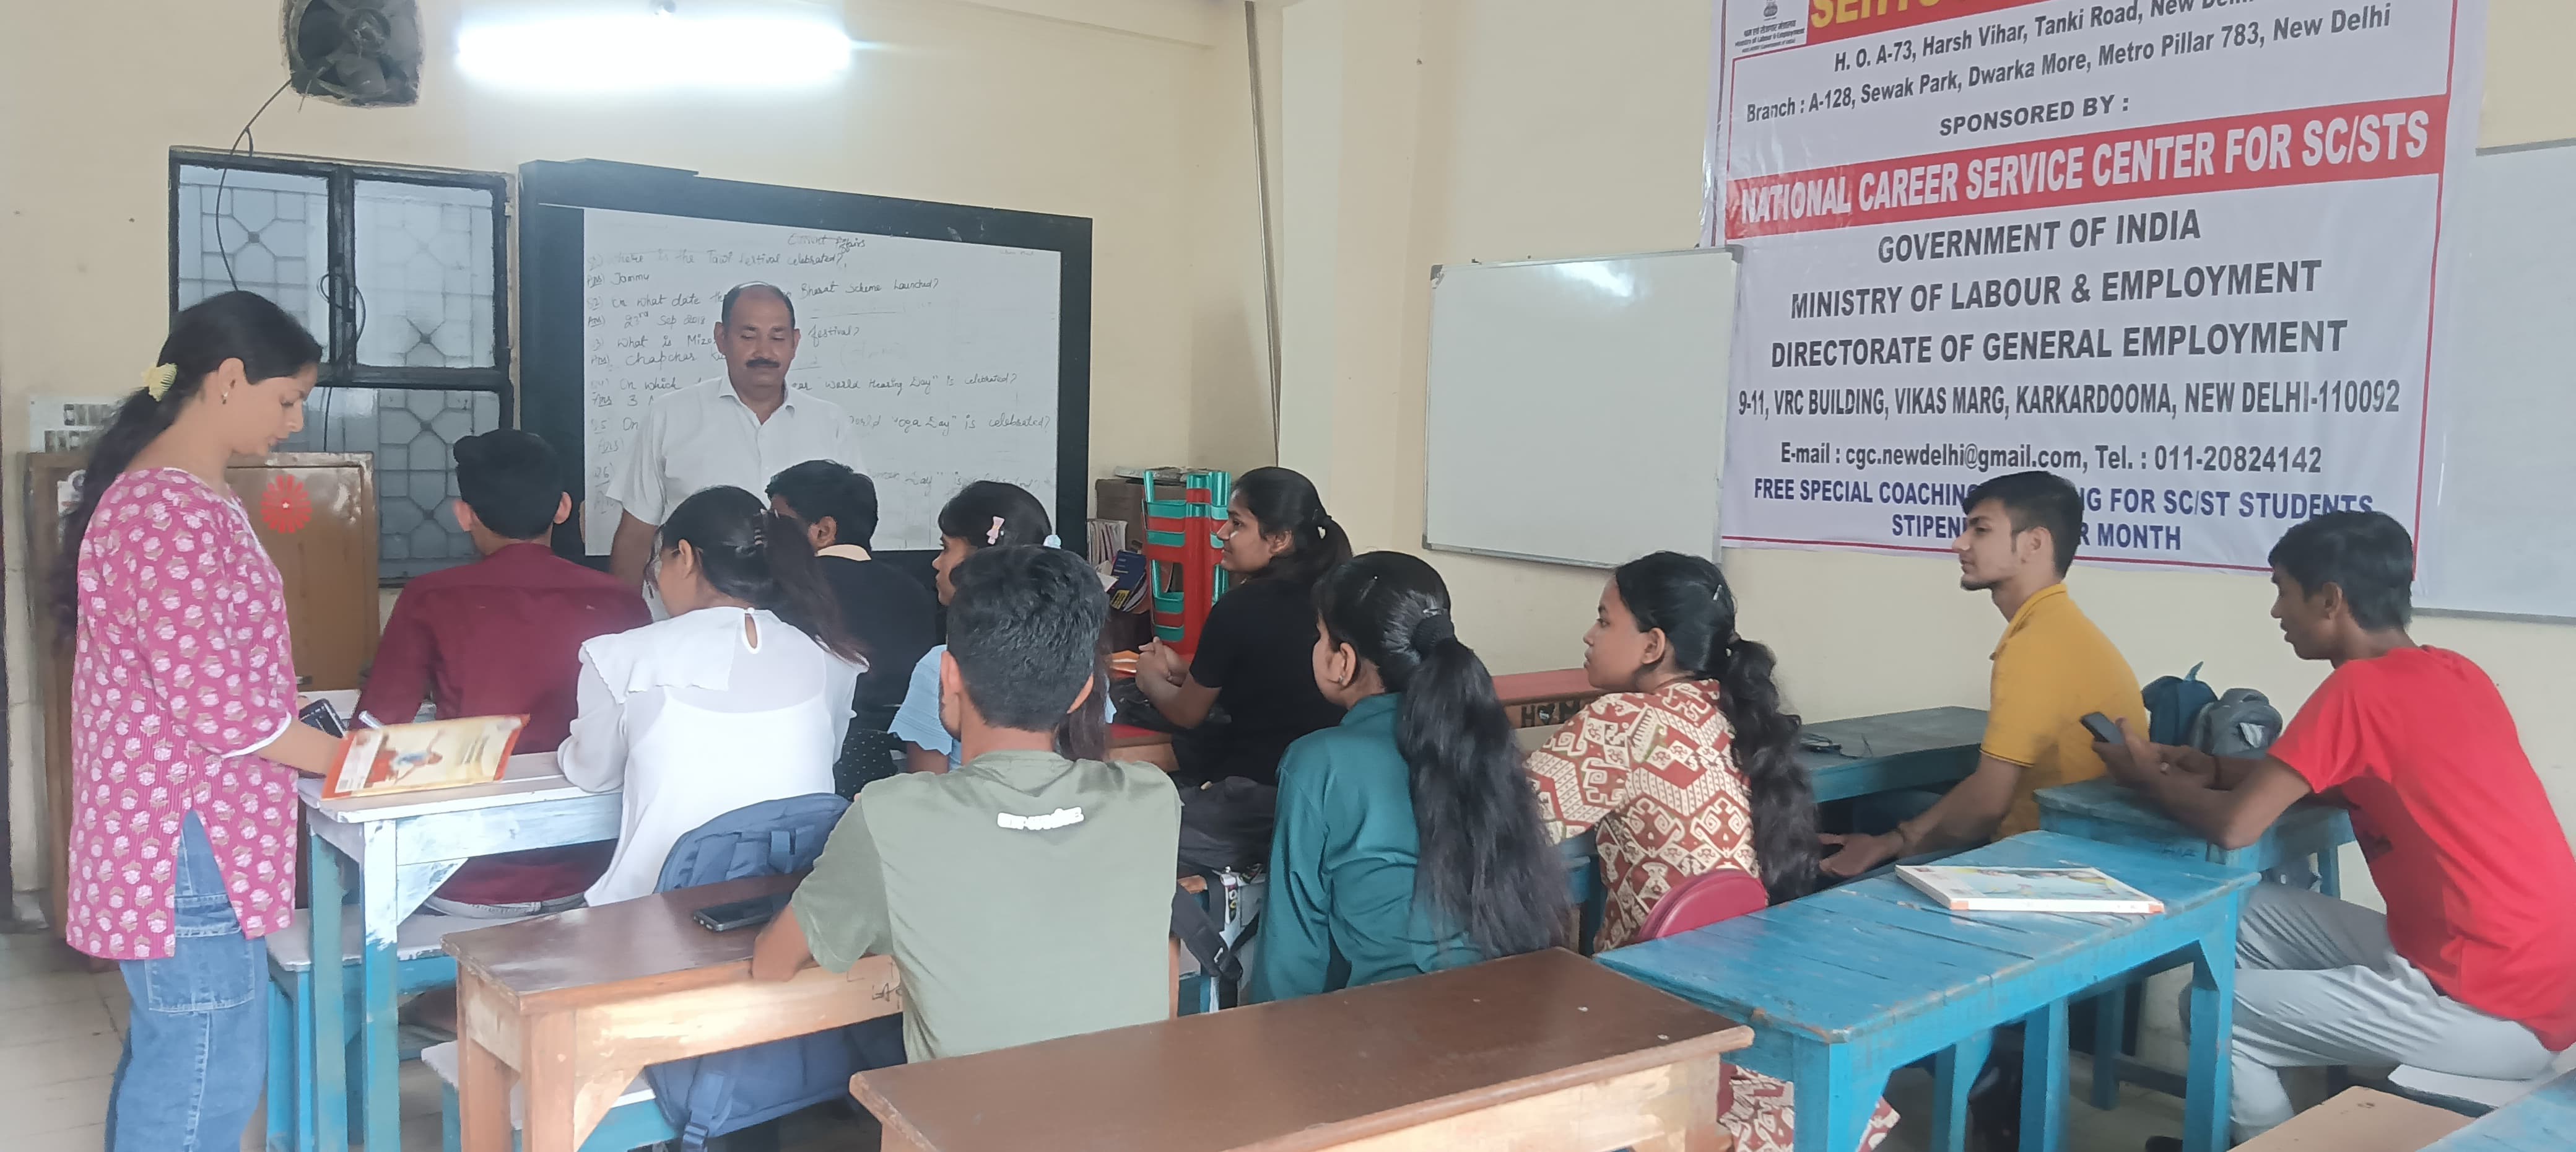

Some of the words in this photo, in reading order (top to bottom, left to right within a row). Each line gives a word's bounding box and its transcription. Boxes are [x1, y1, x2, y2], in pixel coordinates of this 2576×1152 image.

[1835, 52, 1850, 72] H.
[1856, 49, 1870, 68] O.
[1876, 40, 1916, 64] A-73,
[1923, 30, 1972, 56] Harsh
[1979, 24, 2027, 46] Vihar,
[2035, 9, 2084, 37] Tanki
[2091, 0, 2143, 27] Road,
[2151, 0, 2194, 17] New
[1747, 97, 1795, 122] Branch
[1801, 100, 1804, 113] :
[1809, 87, 1855, 111] A-128,
[1861, 77, 1913, 103] Sewak
[1920, 71, 1962, 94] Park,
[1969, 59, 2034, 86] Dwarka
[2042, 53, 2091, 75] More,
[2099, 41, 2154, 66] Metro
[2162, 32, 2214, 56] Pillar
[2222, 22, 2264, 48] 783,
[2274, 17, 2323, 40] New
[2331, 3, 2390, 33] Delhi
[1940, 101, 2074, 136] SPONSORED
[2083, 95, 2115, 116] BY
[2123, 98, 2128, 111] :
[1741, 177, 1852, 224] NATIONAL
[1859, 163, 1958, 211] CAREER
[1966, 147, 2084, 199] SERVICE
[2093, 133, 2214, 186] CENTER
[2226, 124, 2291, 173] FOR
[2302, 110, 2429, 166] SC/STS
[1879, 221, 2060, 263] GOVERNMENT
[2070, 217, 2106, 248] OF
[2117, 209, 2200, 244] INDIA
[1791, 287, 1902, 318] MINISTRY
[1911, 284, 1943, 312] OF
[1952, 276, 2060, 309] LABOUR
[2071, 274, 2091, 303] &
[2102, 260, 2321, 301] EMPLOYMENT
[1772, 336, 1931, 367] DIRECTORATE
[1941, 334, 1973, 362] OF
[1983, 329, 2112, 360] GENERAL
[2123, 320, 2348, 357] EMPLOYMENT
[1739, 390, 1769, 420] 9-11,
[1775, 390, 1803, 415] VRC
[1809, 388, 1888, 420] BUILDING,
[1895, 387, 1946, 414] VIKAS
[1953, 386, 2009, 420] MARG,
[2016, 383, 2176, 419] KARKARDOOMA,
[2185, 383, 2235, 412] NEW
[2242, 380, 2399, 412] DELHI-110092
[623, 417, 639, 430] On
[1782, 442, 1829, 463] E-mail
[1836, 448, 1840, 463] :
[1846, 443, 2087, 473] cgc.newdelhi@gmail.com,
[2095, 445, 2133, 469] Tel.
[2142, 452, 2146, 469] :
[2155, 445, 2321, 473] 011-20824142
[1755, 478, 1794, 499] FREE
[1800, 479, 1873, 502] SPECIAL
[2110, 489, 2156, 513] FOR
[2164, 490, 2230, 516] SC/ST
[1892, 514, 1968, 539] STIPEN
[2098, 523, 2180, 550] MONTH
